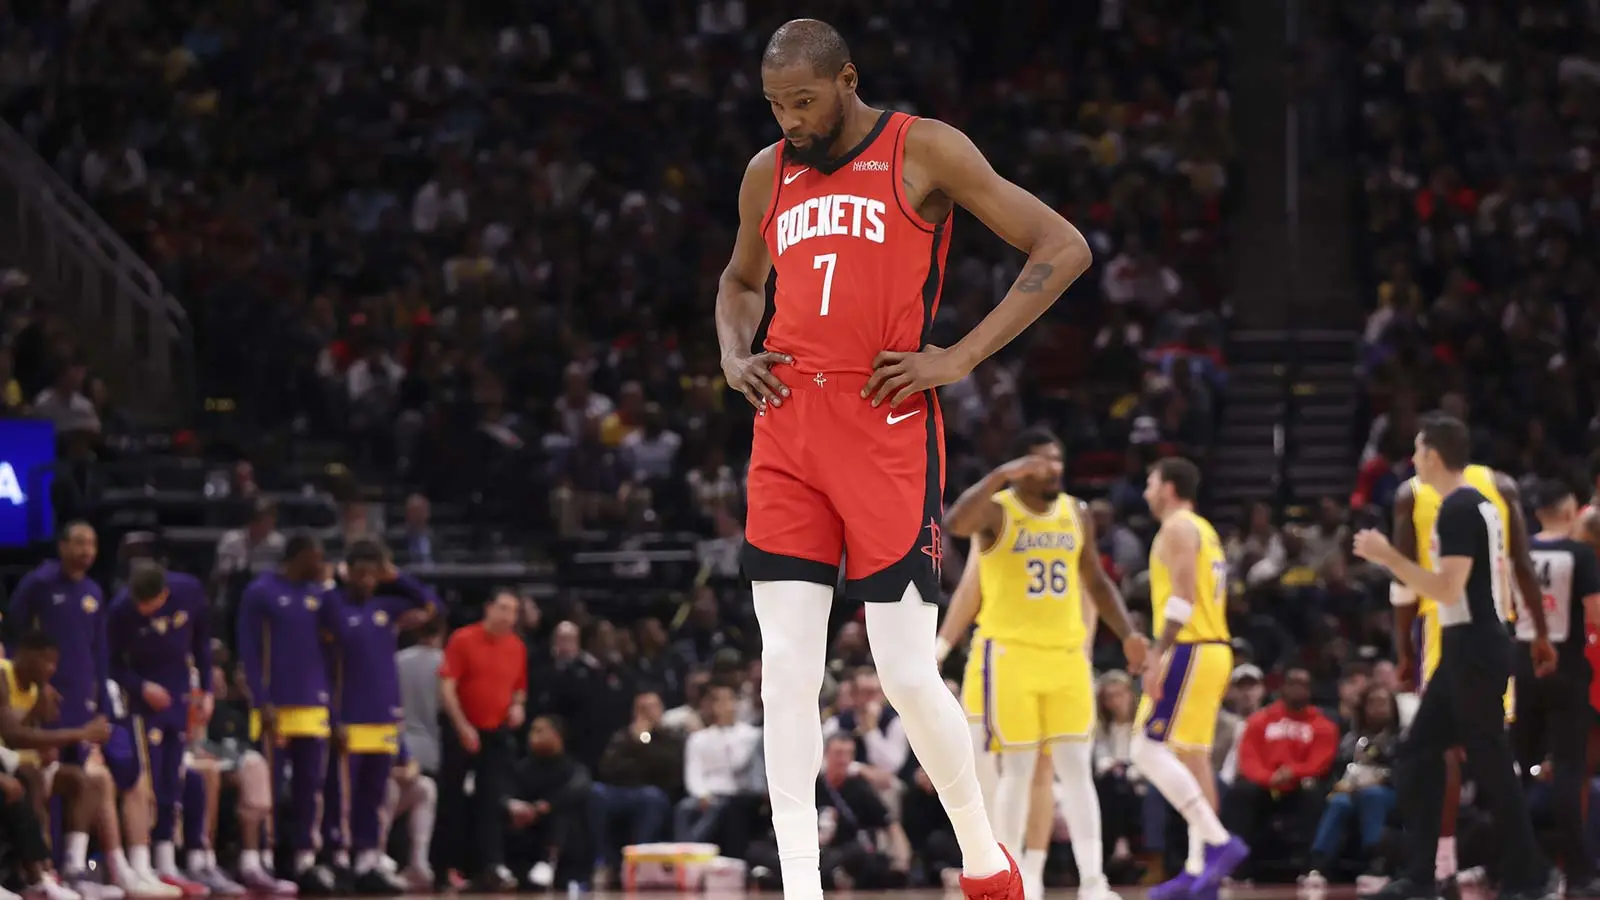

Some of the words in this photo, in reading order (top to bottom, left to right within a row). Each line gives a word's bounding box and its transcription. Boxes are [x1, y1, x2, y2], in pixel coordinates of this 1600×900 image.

[777, 194, 886, 257] ROCKETS
[813, 252, 837, 316] 7
[1026, 559, 1067, 596] 36
